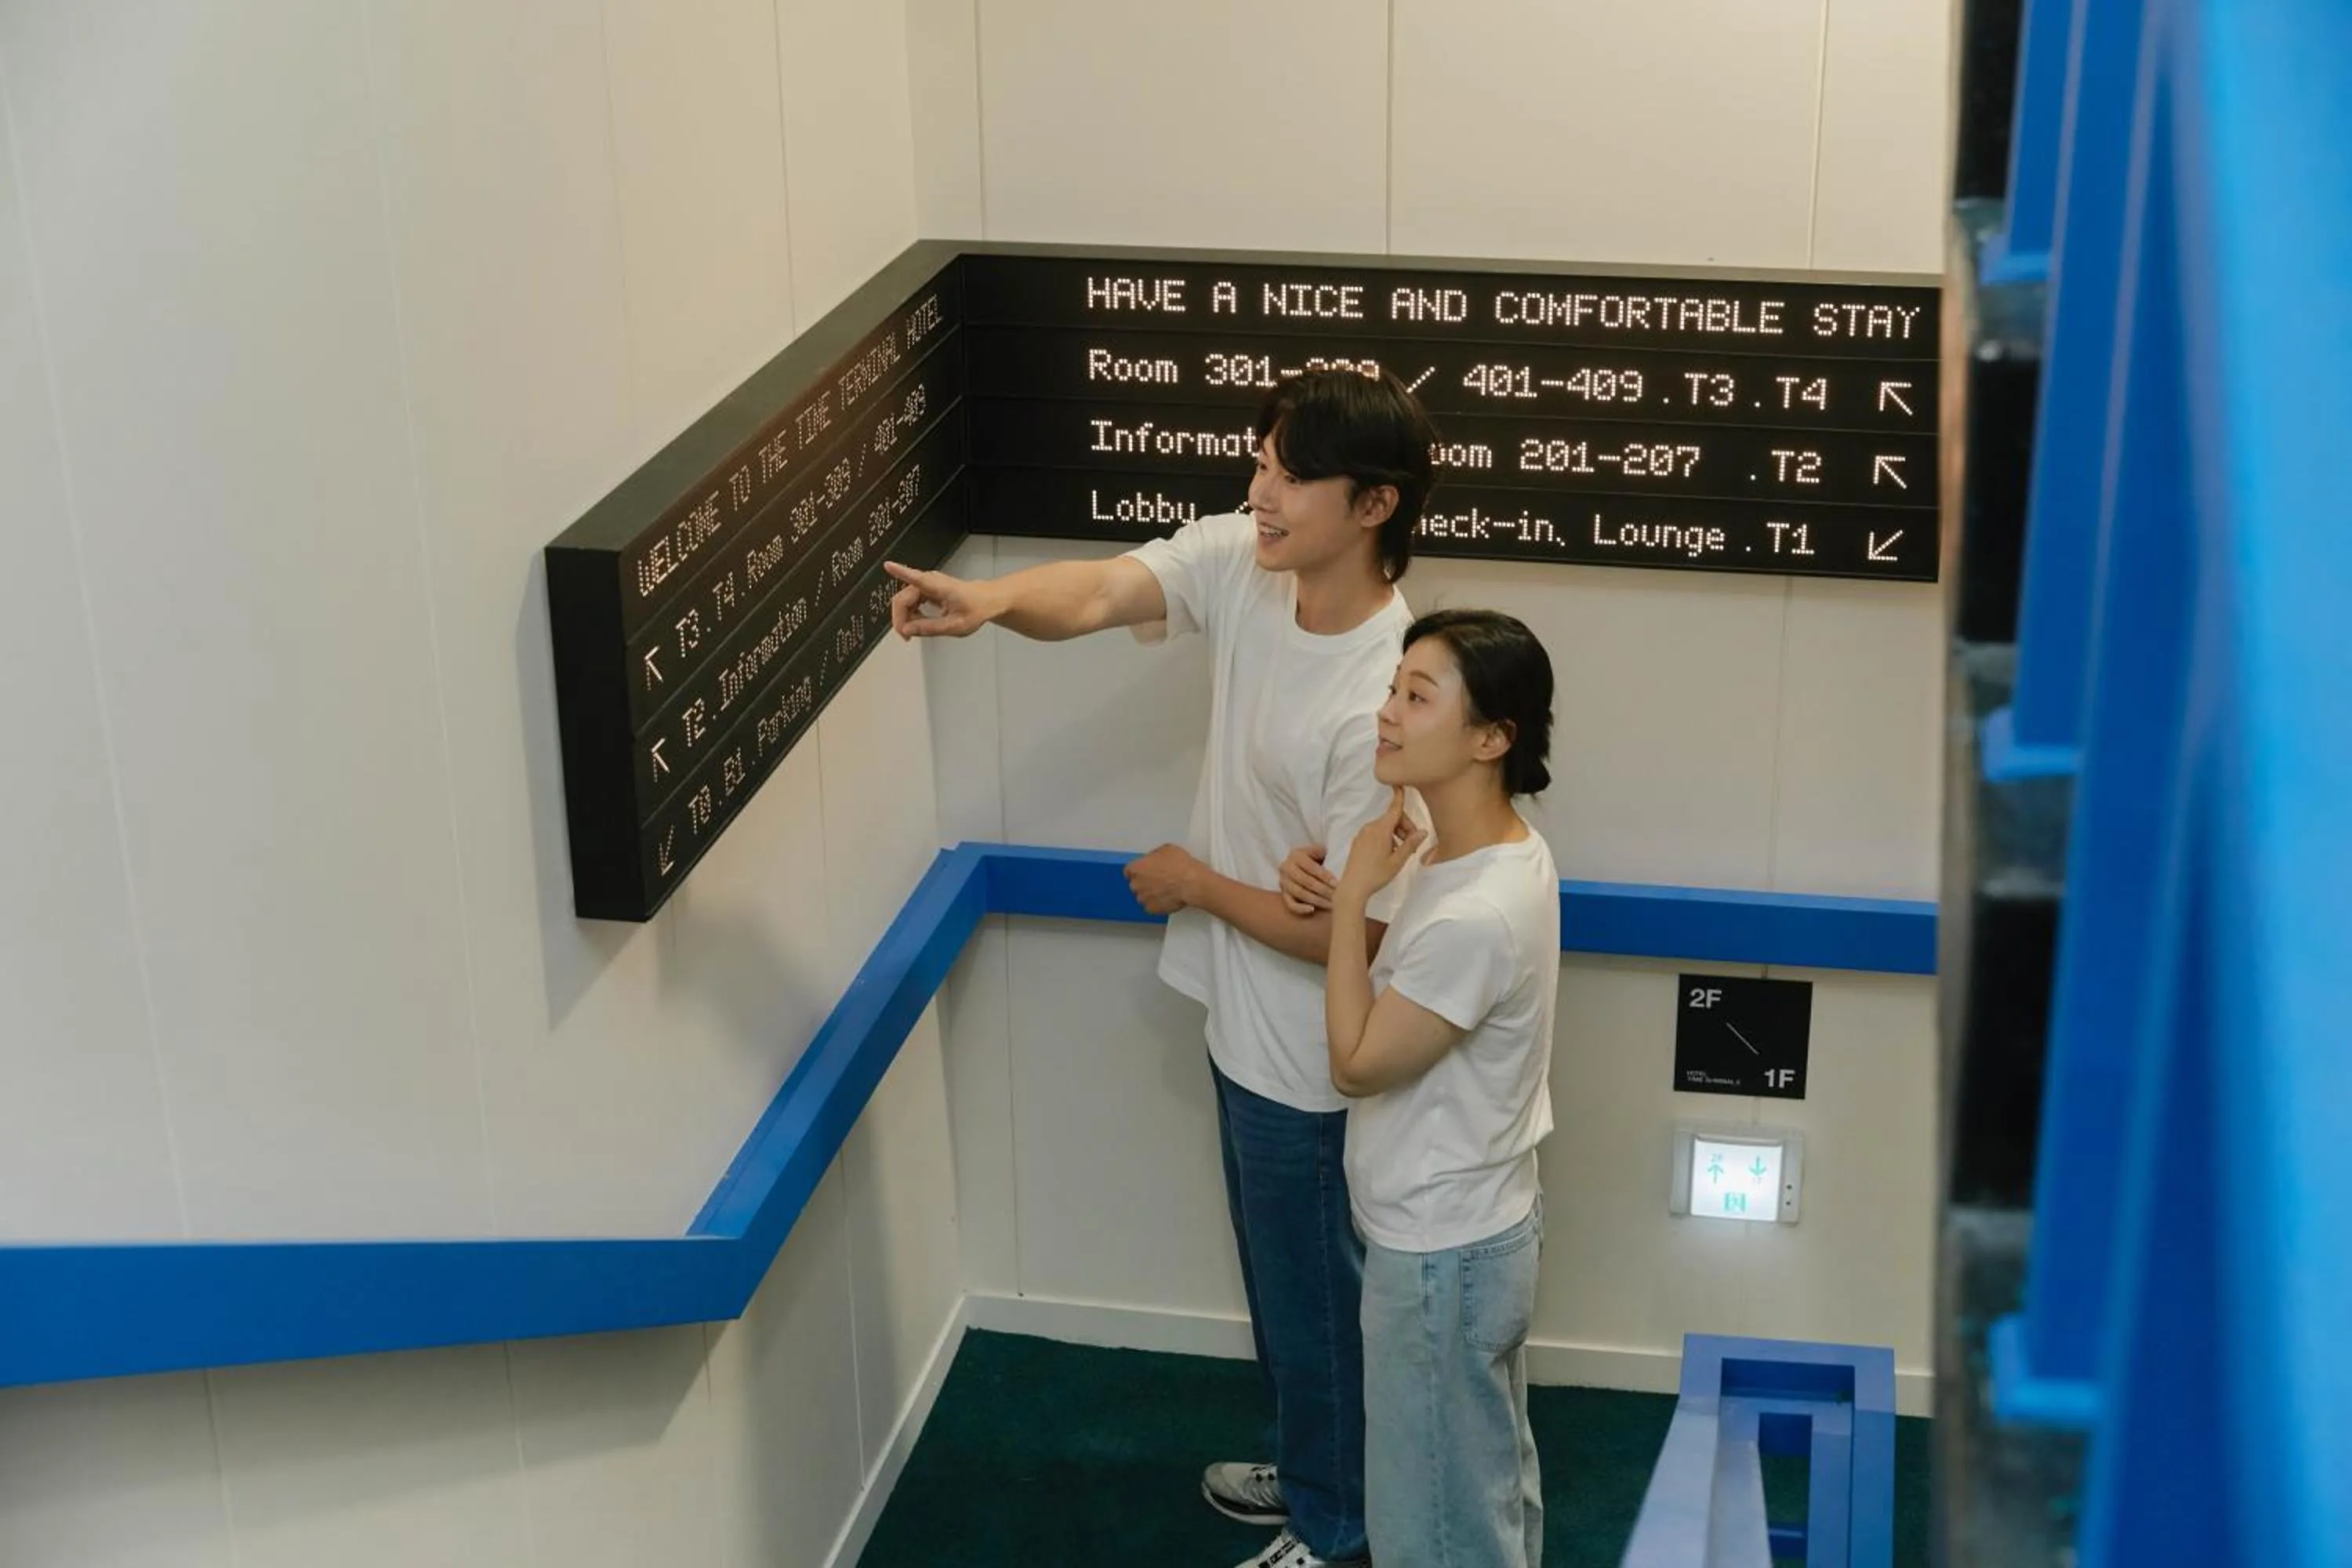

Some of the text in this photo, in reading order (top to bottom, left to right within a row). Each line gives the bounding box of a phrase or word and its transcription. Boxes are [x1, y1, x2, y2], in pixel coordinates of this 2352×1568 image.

[1087, 277, 1920, 339] HAVE A NICE AND COMFORTABLE STAY
[1089, 349, 1178, 383] Room
[1463, 364, 1643, 402] 401-409
[637, 293, 942, 597] WELCOME TO THE TIME TERMINAL HOTEL
[1091, 419, 1259, 457] Informat
[1428, 443, 1493, 468] oom
[1520, 438, 1700, 477] 201-207
[789, 457, 851, 543] 301-309
[1092, 490, 1196, 524] Lobby
[832, 535, 863, 587] Room
[869, 464, 920, 546] 201-207
[1594, 514, 1725, 557] Lounge
[1690, 989, 1722, 1007] 2F
[1765, 1069, 1795, 1087] 1F
